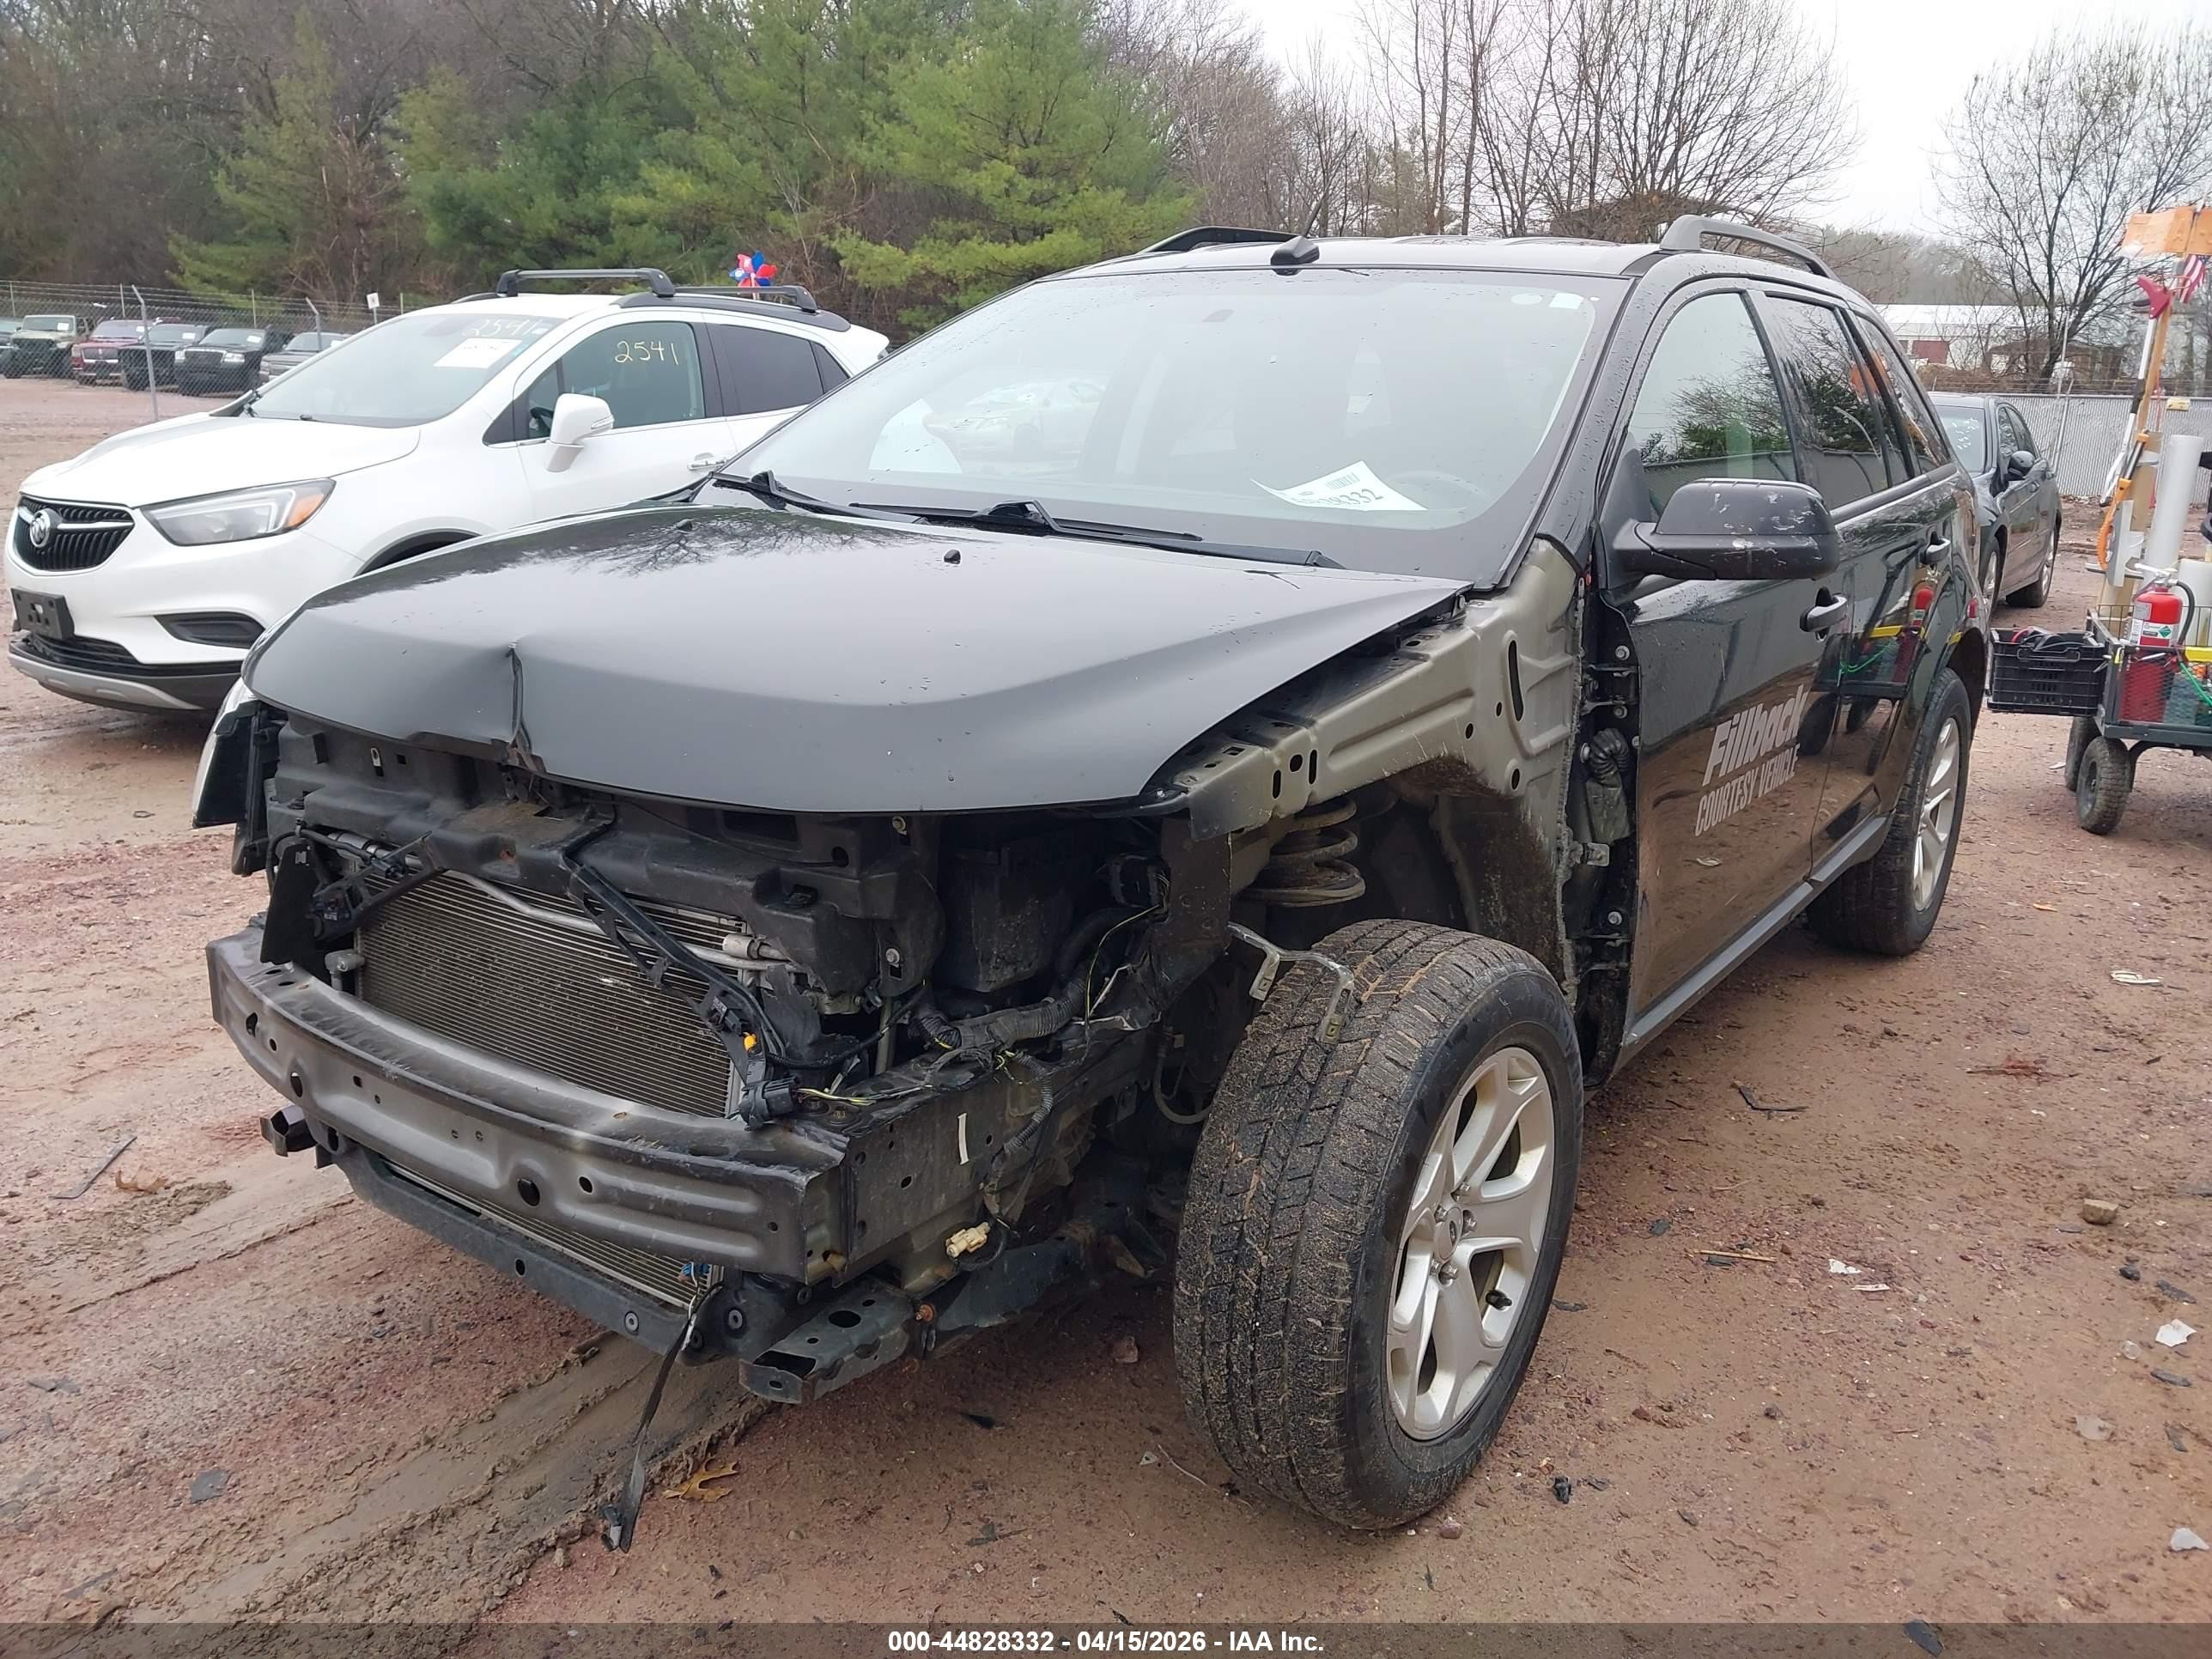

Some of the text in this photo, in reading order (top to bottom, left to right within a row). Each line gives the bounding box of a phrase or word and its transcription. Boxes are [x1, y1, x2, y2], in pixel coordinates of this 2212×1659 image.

[461, 319, 544, 337] 2541
[614, 340, 679, 365] 2541
[1702, 684, 1809, 787] Fillback
[1694, 743, 1801, 837] COURTESY VEHICLE
